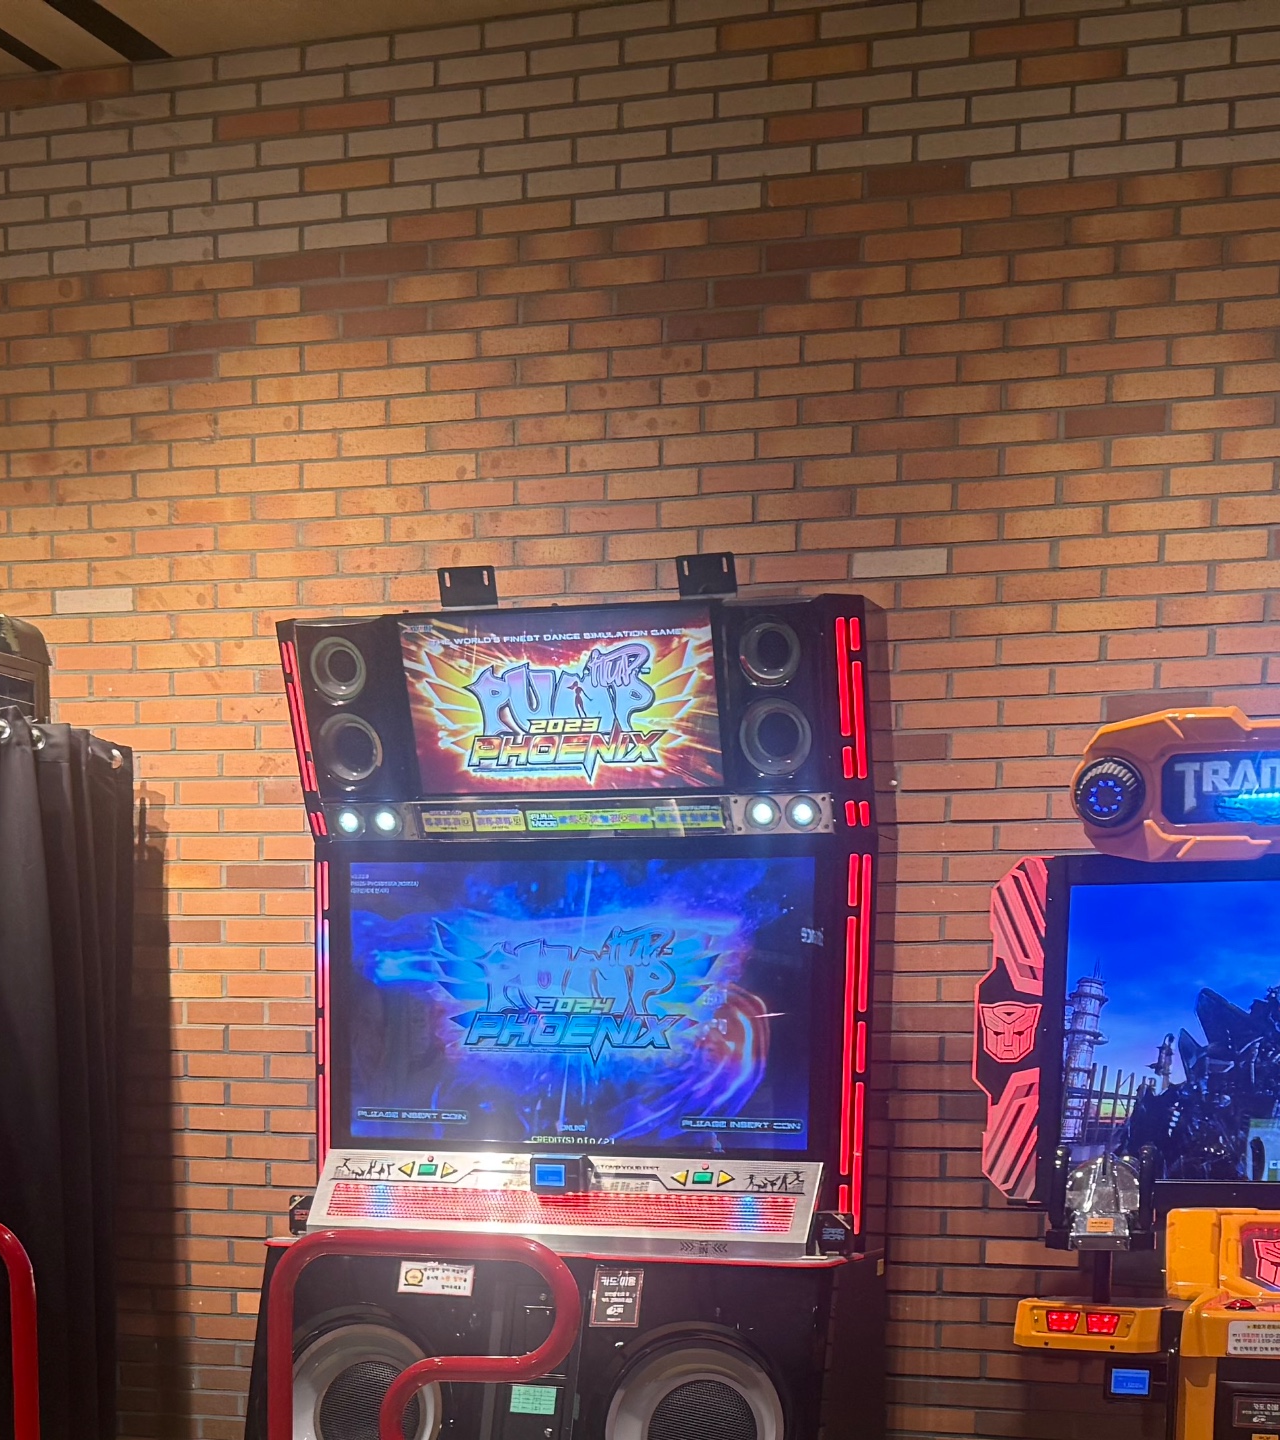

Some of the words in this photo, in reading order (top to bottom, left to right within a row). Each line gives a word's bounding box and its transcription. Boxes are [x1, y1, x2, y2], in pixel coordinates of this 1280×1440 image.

[454, 637, 500, 645] WORLD'S
[504, 635, 540, 643] FINEST
[543, 633, 581, 641] DANCE
[583, 630, 648, 639] SIMULATION
[468, 661, 656, 735] PUMP
[527, 718, 600, 734] 2023
[468, 730, 667, 781] PHOENIX
[536, 997, 615, 1013] 2024
[464, 1011, 680, 1064] PHOENIX
[401, 1111, 438, 1120] INSERT
[441, 1113, 468, 1121] COIN
[729, 1120, 770, 1129] INSERT
[773, 1121, 802, 1130] COIN
[601, 1276, 619, 1286] 카드
